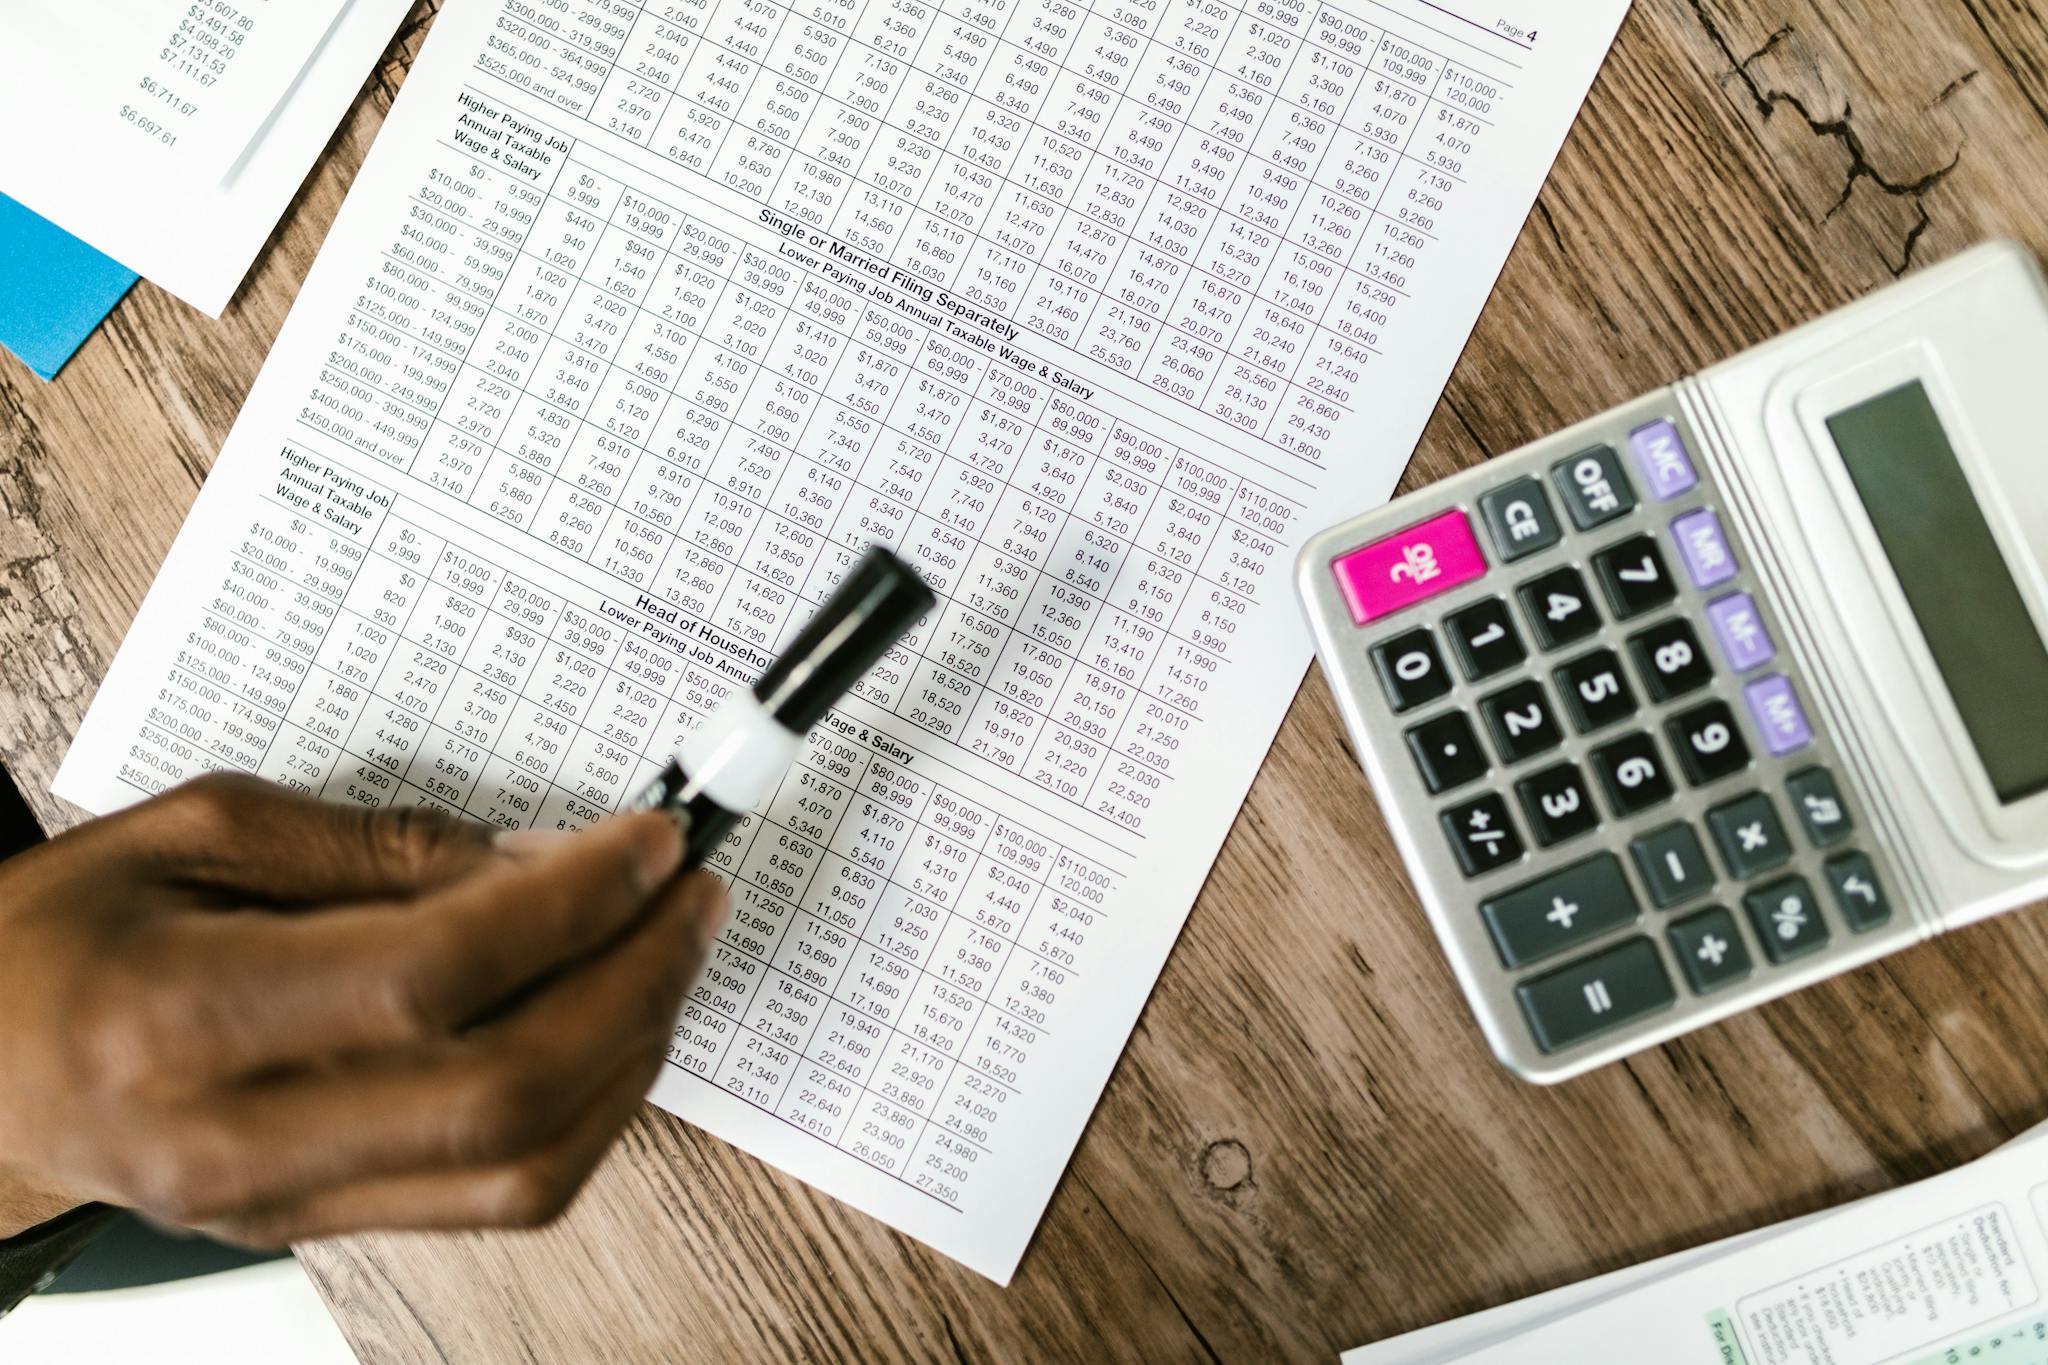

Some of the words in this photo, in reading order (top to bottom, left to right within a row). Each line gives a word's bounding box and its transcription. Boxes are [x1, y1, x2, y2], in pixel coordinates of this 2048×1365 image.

[198, 0, 253, 31] 3,607.80
[1496, 18, 1524, 38] Page
[1525, 30, 1538, 43] 4
[1248, 22, 1291, 50] $1,020
[1310, 51, 1354, 78] $1,100
[1373, 79, 1417, 107] $1,870
[1436, 108, 1480, 136] $1,870
[456, 91, 501, 120] Higher
[500, 112, 543, 144] Paying
[543, 135, 569, 154] Job
[456, 112, 504, 142] Annual
[504, 132, 552, 165] Taxable
[453, 128, 489, 154] Wage
[489, 147, 500, 161] &
[501, 152, 542, 181] Salary
[476, 52, 532, 87] $525,000
[531, 82, 557, 99] and
[556, 94, 584, 112] over
[608, 116, 642, 140] 3,140
[668, 145, 702, 168] 6,840
[723, 170, 762, 197] 10,200
[783, 199, 823, 225] 12,900
[844, 227, 884, 254] 15,530
[906, 256, 946, 283] 18,030
[964, 284, 1008, 312] 20,530
[1026, 314, 1070, 341] 23,030
[1088, 343, 1132, 371] 25,530
[1151, 373, 1195, 401] 28,030
[1214, 402, 1258, 430] 30,300
[1278, 432, 1322, 460] 31,800
[757, 208, 806, 240] Single
[808, 234, 828, 249] or
[827, 240, 891, 280] Married
[890, 270, 934, 303] Filing
[935, 291, 1020, 342] Separately
[777, 241, 821, 269] Lower
[820, 261, 867, 294] Paying
[867, 285, 894, 305] Job
[893, 297, 944, 328] Annual
[945, 318, 996, 353] Taxable
[998, 344, 1037, 372] Wage
[1037, 364, 1049, 379] &
[1050, 370, 1095, 401] Salary
[279, 445, 322, 474] Higher
[321, 466, 365, 498] Paying
[365, 489, 390, 508] Job
[1649, 436, 1688, 483] MC
[279, 466, 325, 495] Annual
[325, 487, 373, 520] Taxable
[365, 276, 420, 310] $100,000
[430, 308, 476, 337] 124,999
[495, 339, 530, 363] 2,040
[555, 368, 590, 392] 3,840
[615, 397, 650, 422] 5,120
[675, 427, 711, 451] 6,320
[737, 456, 772, 481] 7,520
[797, 486, 833, 510] 8,360
[859, 515, 894, 540] 9,360
[916, 543, 957, 570] 10,360
[978, 573, 1019, 601] 11,360
[1040, 603, 1082, 631] 12,360
[1104, 634, 1145, 661] 13,410
[1167, 664, 1208, 692] 14,510
[1573, 458, 1619, 512] OFF
[275, 482, 310, 509] Wage
[311, 501, 322, 515] &
[323, 507, 363, 536] Salary
[1504, 500, 1541, 542] CE
[1619, 556, 1659, 582] 7
[1690, 524, 1726, 571] MR
[299, 406, 354, 441] $450,000
[353, 436, 379, 453] and
[378, 448, 405, 465] over
[429, 470, 463, 494] 3,140
[489, 500, 523, 524] 6,250
[548, 529, 584, 554] 8,830
[604, 556, 644, 584] 11,330
[665, 586, 705, 614] 13,830
[726, 616, 766, 644] 15,790
[909, 707, 952, 735] 20,290
[971, 737, 1015, 766] 21,790
[1034, 768, 1078, 797] 23,100
[1097, 800, 1141, 829] 24,400
[1547, 592, 1582, 622] 4
[634, 593, 679, 625] Head
[678, 618, 699, 634] of
[697, 624, 772, 671] Househol
[1471, 622, 1506, 648] 1
[1396, 652, 1432, 681] 0
[1655, 640, 1693, 673] 8
[598, 599, 642, 629] Lower
[641, 620, 688, 654] Paying
[687, 645, 714, 665] Job
[714, 658, 761, 688] Annua
[857, 728, 870, 743] &
[870, 734, 915, 765] Salary
[1579, 672, 1620, 704] 5
[1503, 703, 1543, 737] 2
[1764, 693, 1799, 733] M+
[240, 541, 288, 572] $20,000
[302, 572, 344, 600] 29,999
[372, 607, 397, 627] 930
[422, 632, 457, 656] 2,130
[482, 662, 517, 687] 2,360
[542, 692, 577, 717] 2,450
[602, 722, 638, 747] 2,850
[787, 814, 823, 840] 5,340
[849, 845, 885, 871] 5,540
[912, 877, 948, 902] 5,740
[975, 908, 1011, 934] 5,870
[1038, 940, 1074, 966] 5,870
[1691, 722, 1731, 754] 9
[1616, 756, 1656, 788] 6
[1541, 786, 1580, 818] 3
[1545, 896, 1579, 929] +
[1771, 896, 1809, 940] %
[1581, 979, 1612, 1014] =
[726, 1076, 770, 1105] 23,110
[788, 1108, 832, 1137] 24,610
[852, 1140, 896, 1169] 26,050
[915, 1173, 959, 1202] 27,350
[1985, 1210, 2015, 1266] Standard
